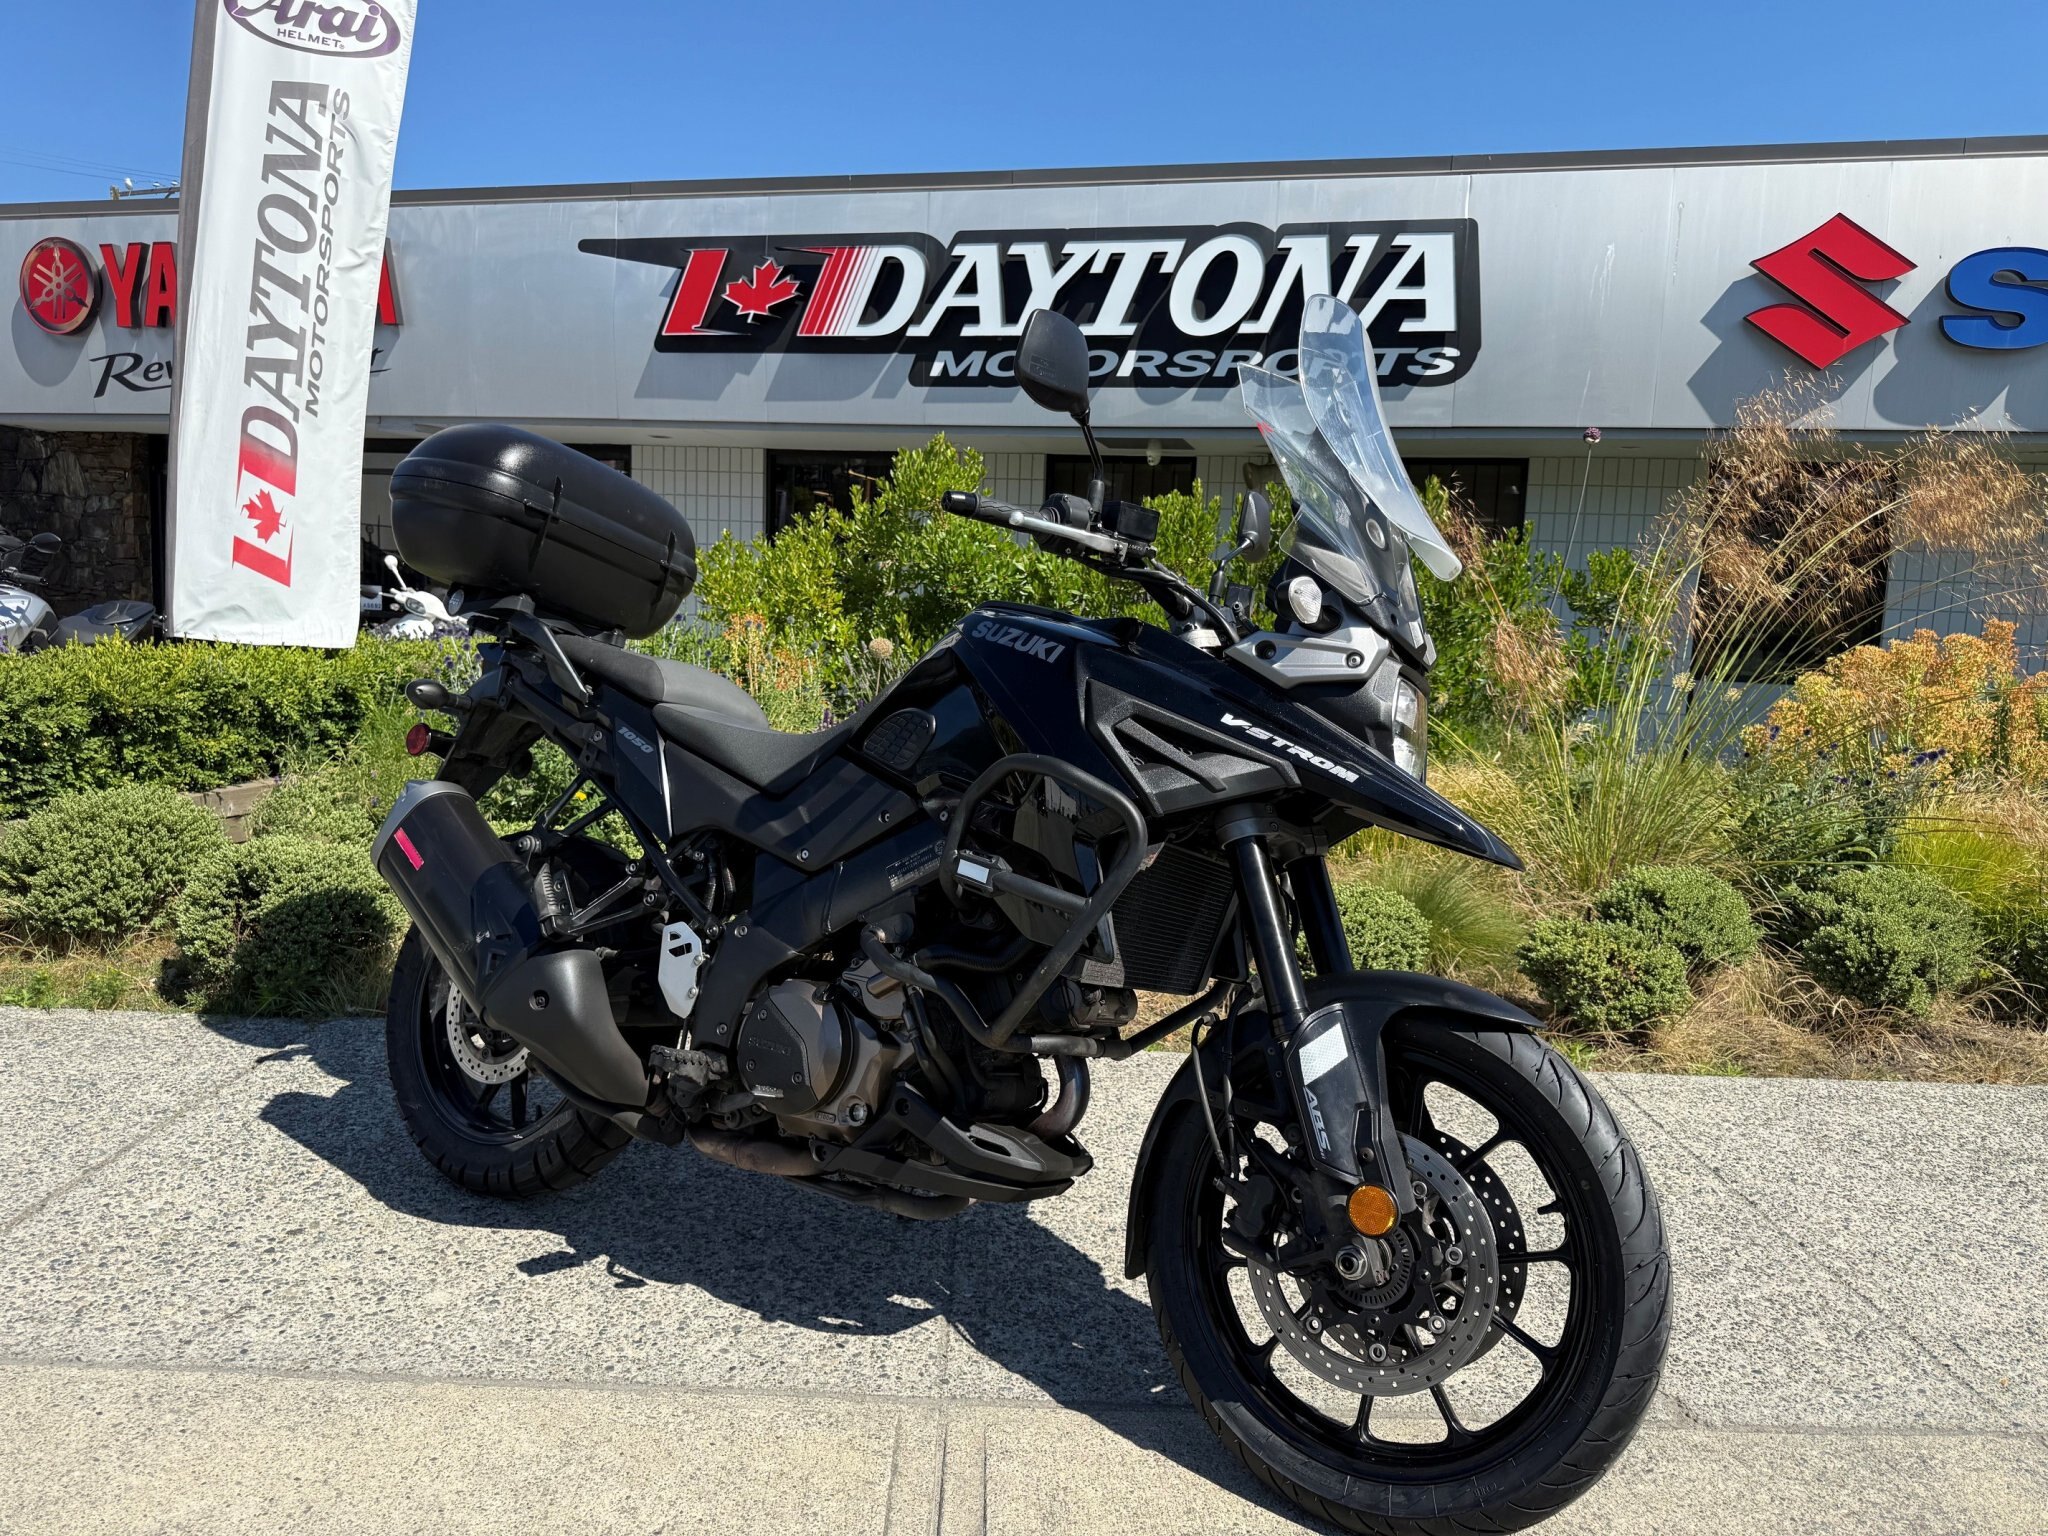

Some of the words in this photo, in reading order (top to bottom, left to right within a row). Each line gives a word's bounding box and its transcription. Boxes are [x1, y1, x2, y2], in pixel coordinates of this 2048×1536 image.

[233, 0, 381, 43] Arai
[276, 28, 342, 50] HELMET
[305, 88, 350, 417] MOTORSPORTS
[236, 80, 329, 497] DAYTONA
[792, 232, 1457, 338] DAYTONA
[929, 346, 1461, 379] MOORSPORTS
[971, 621, 1066, 664] SUZUKI
[616, 726, 654, 753] 1050
[1220, 712, 1360, 783] V-STROM
[1303, 1086, 1331, 1153] ABS
